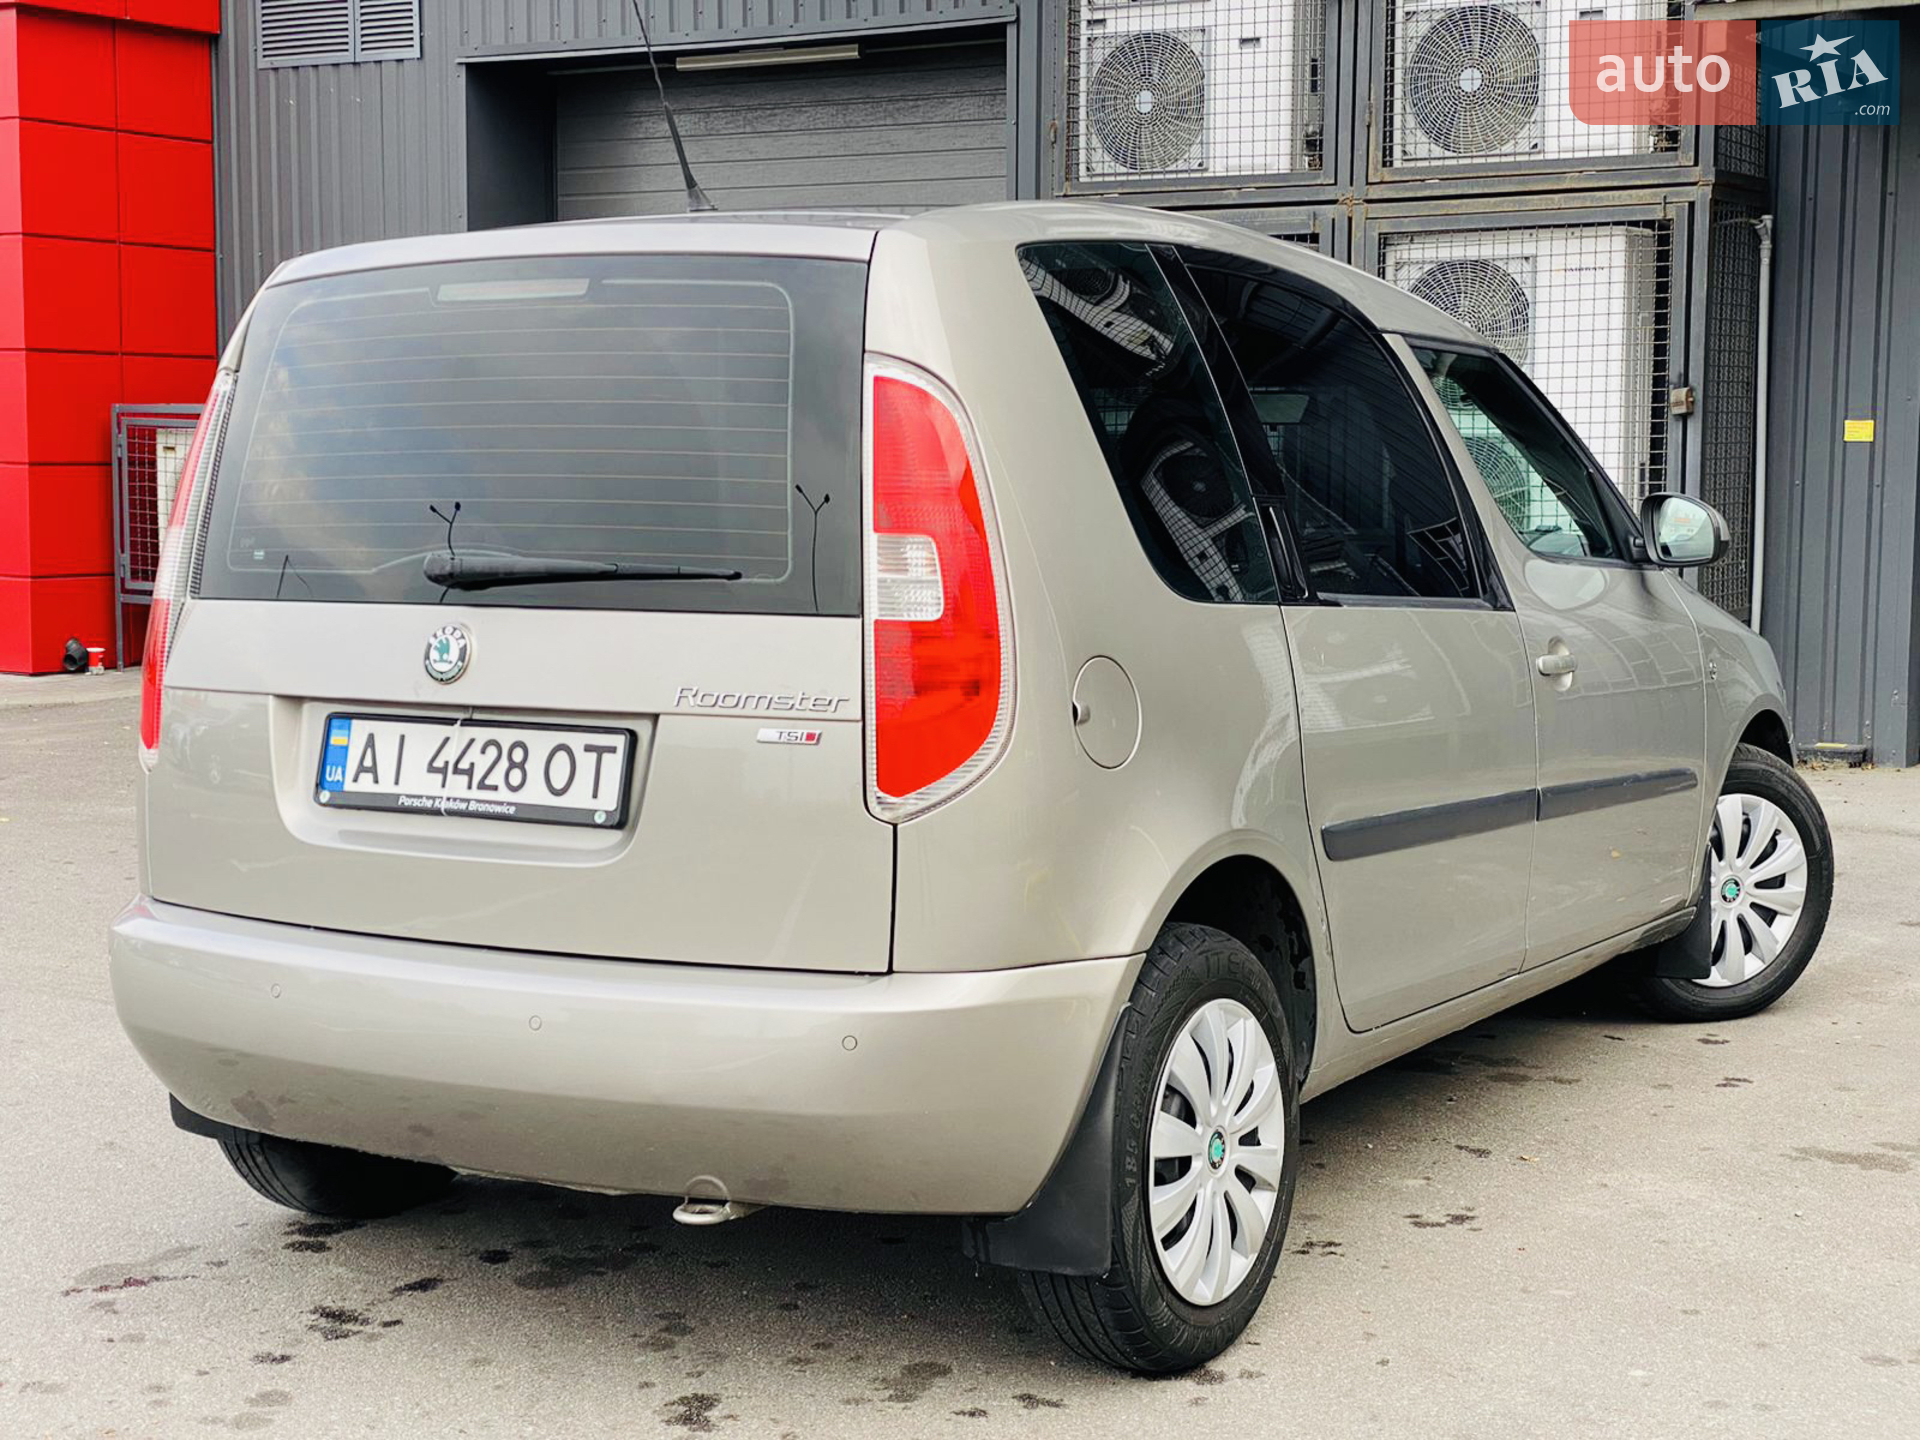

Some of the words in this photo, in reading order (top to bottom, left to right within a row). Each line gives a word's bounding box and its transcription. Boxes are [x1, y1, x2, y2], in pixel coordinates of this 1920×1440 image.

[673, 685, 851, 714] Roomster
[775, 730, 805, 742] TSI
[325, 765, 344, 783] UA
[426, 736, 530, 793] 4428
[543, 743, 618, 799] OT
[398, 795, 434, 808] Porsche
[468, 800, 517, 815] Bronowice
